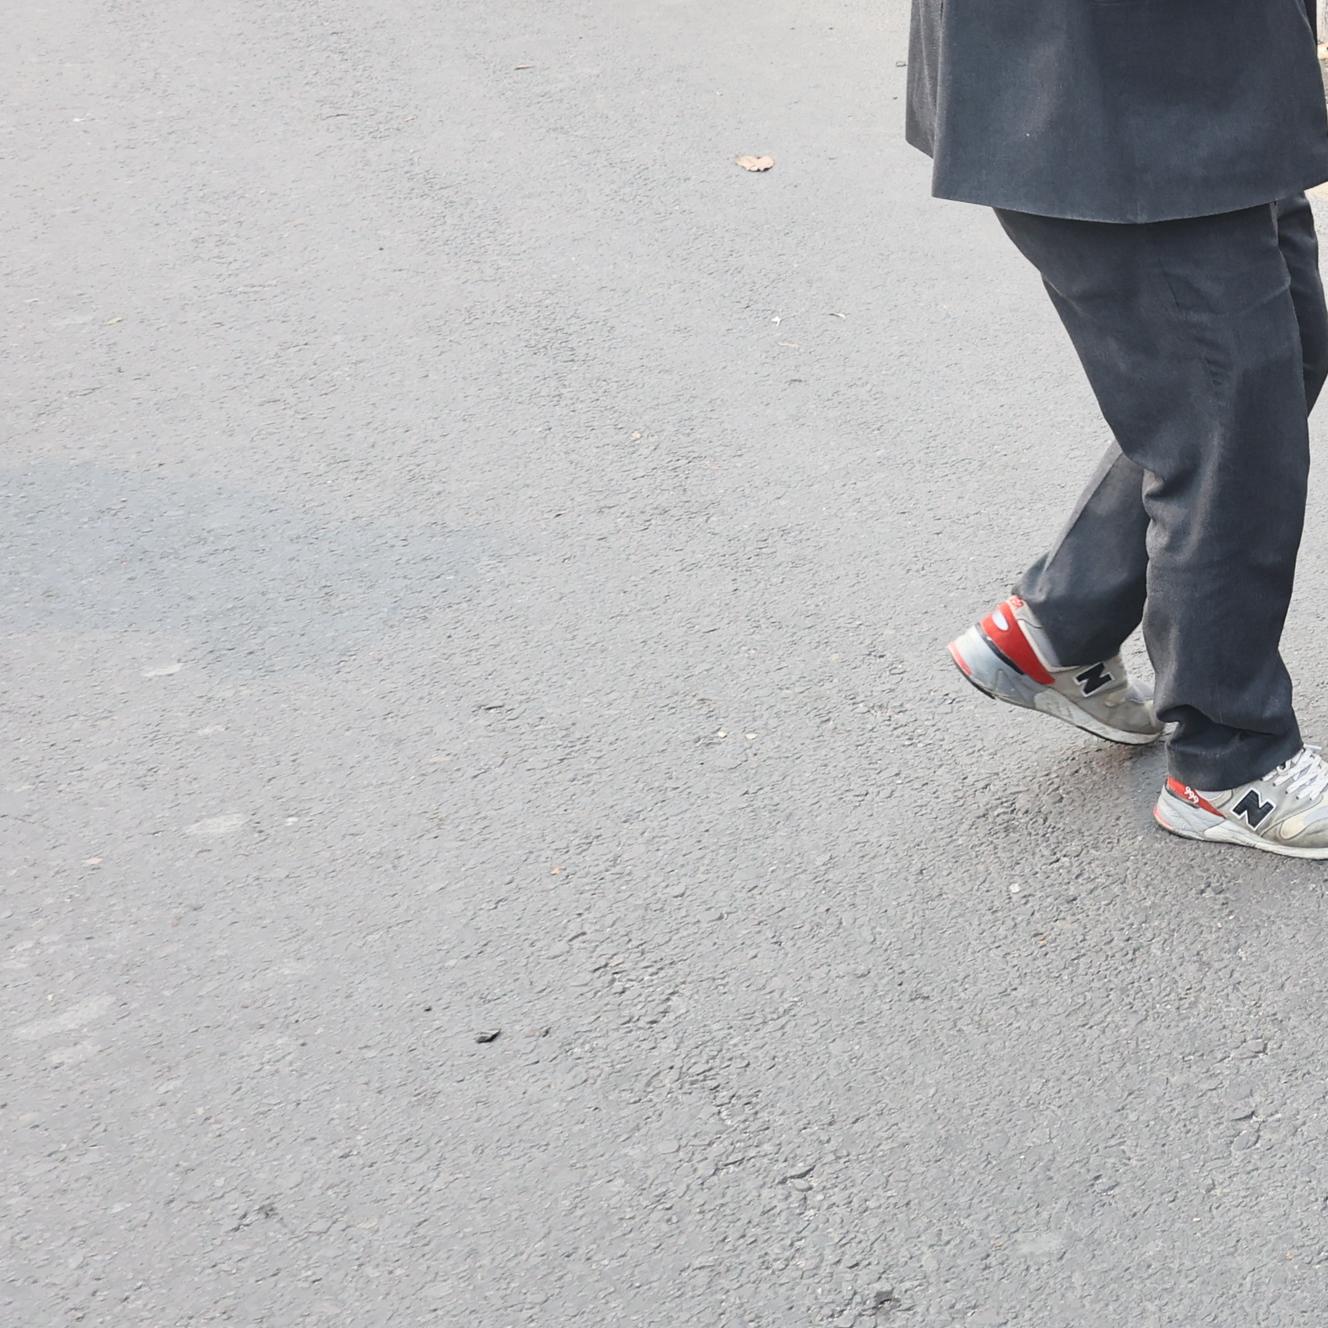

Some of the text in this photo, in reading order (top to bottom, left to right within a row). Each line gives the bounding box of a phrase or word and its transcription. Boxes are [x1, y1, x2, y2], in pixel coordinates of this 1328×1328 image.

[1075, 661, 1115, 697] N
[1183, 785, 1200, 804] 999
[1230, 787, 1276, 831] N
